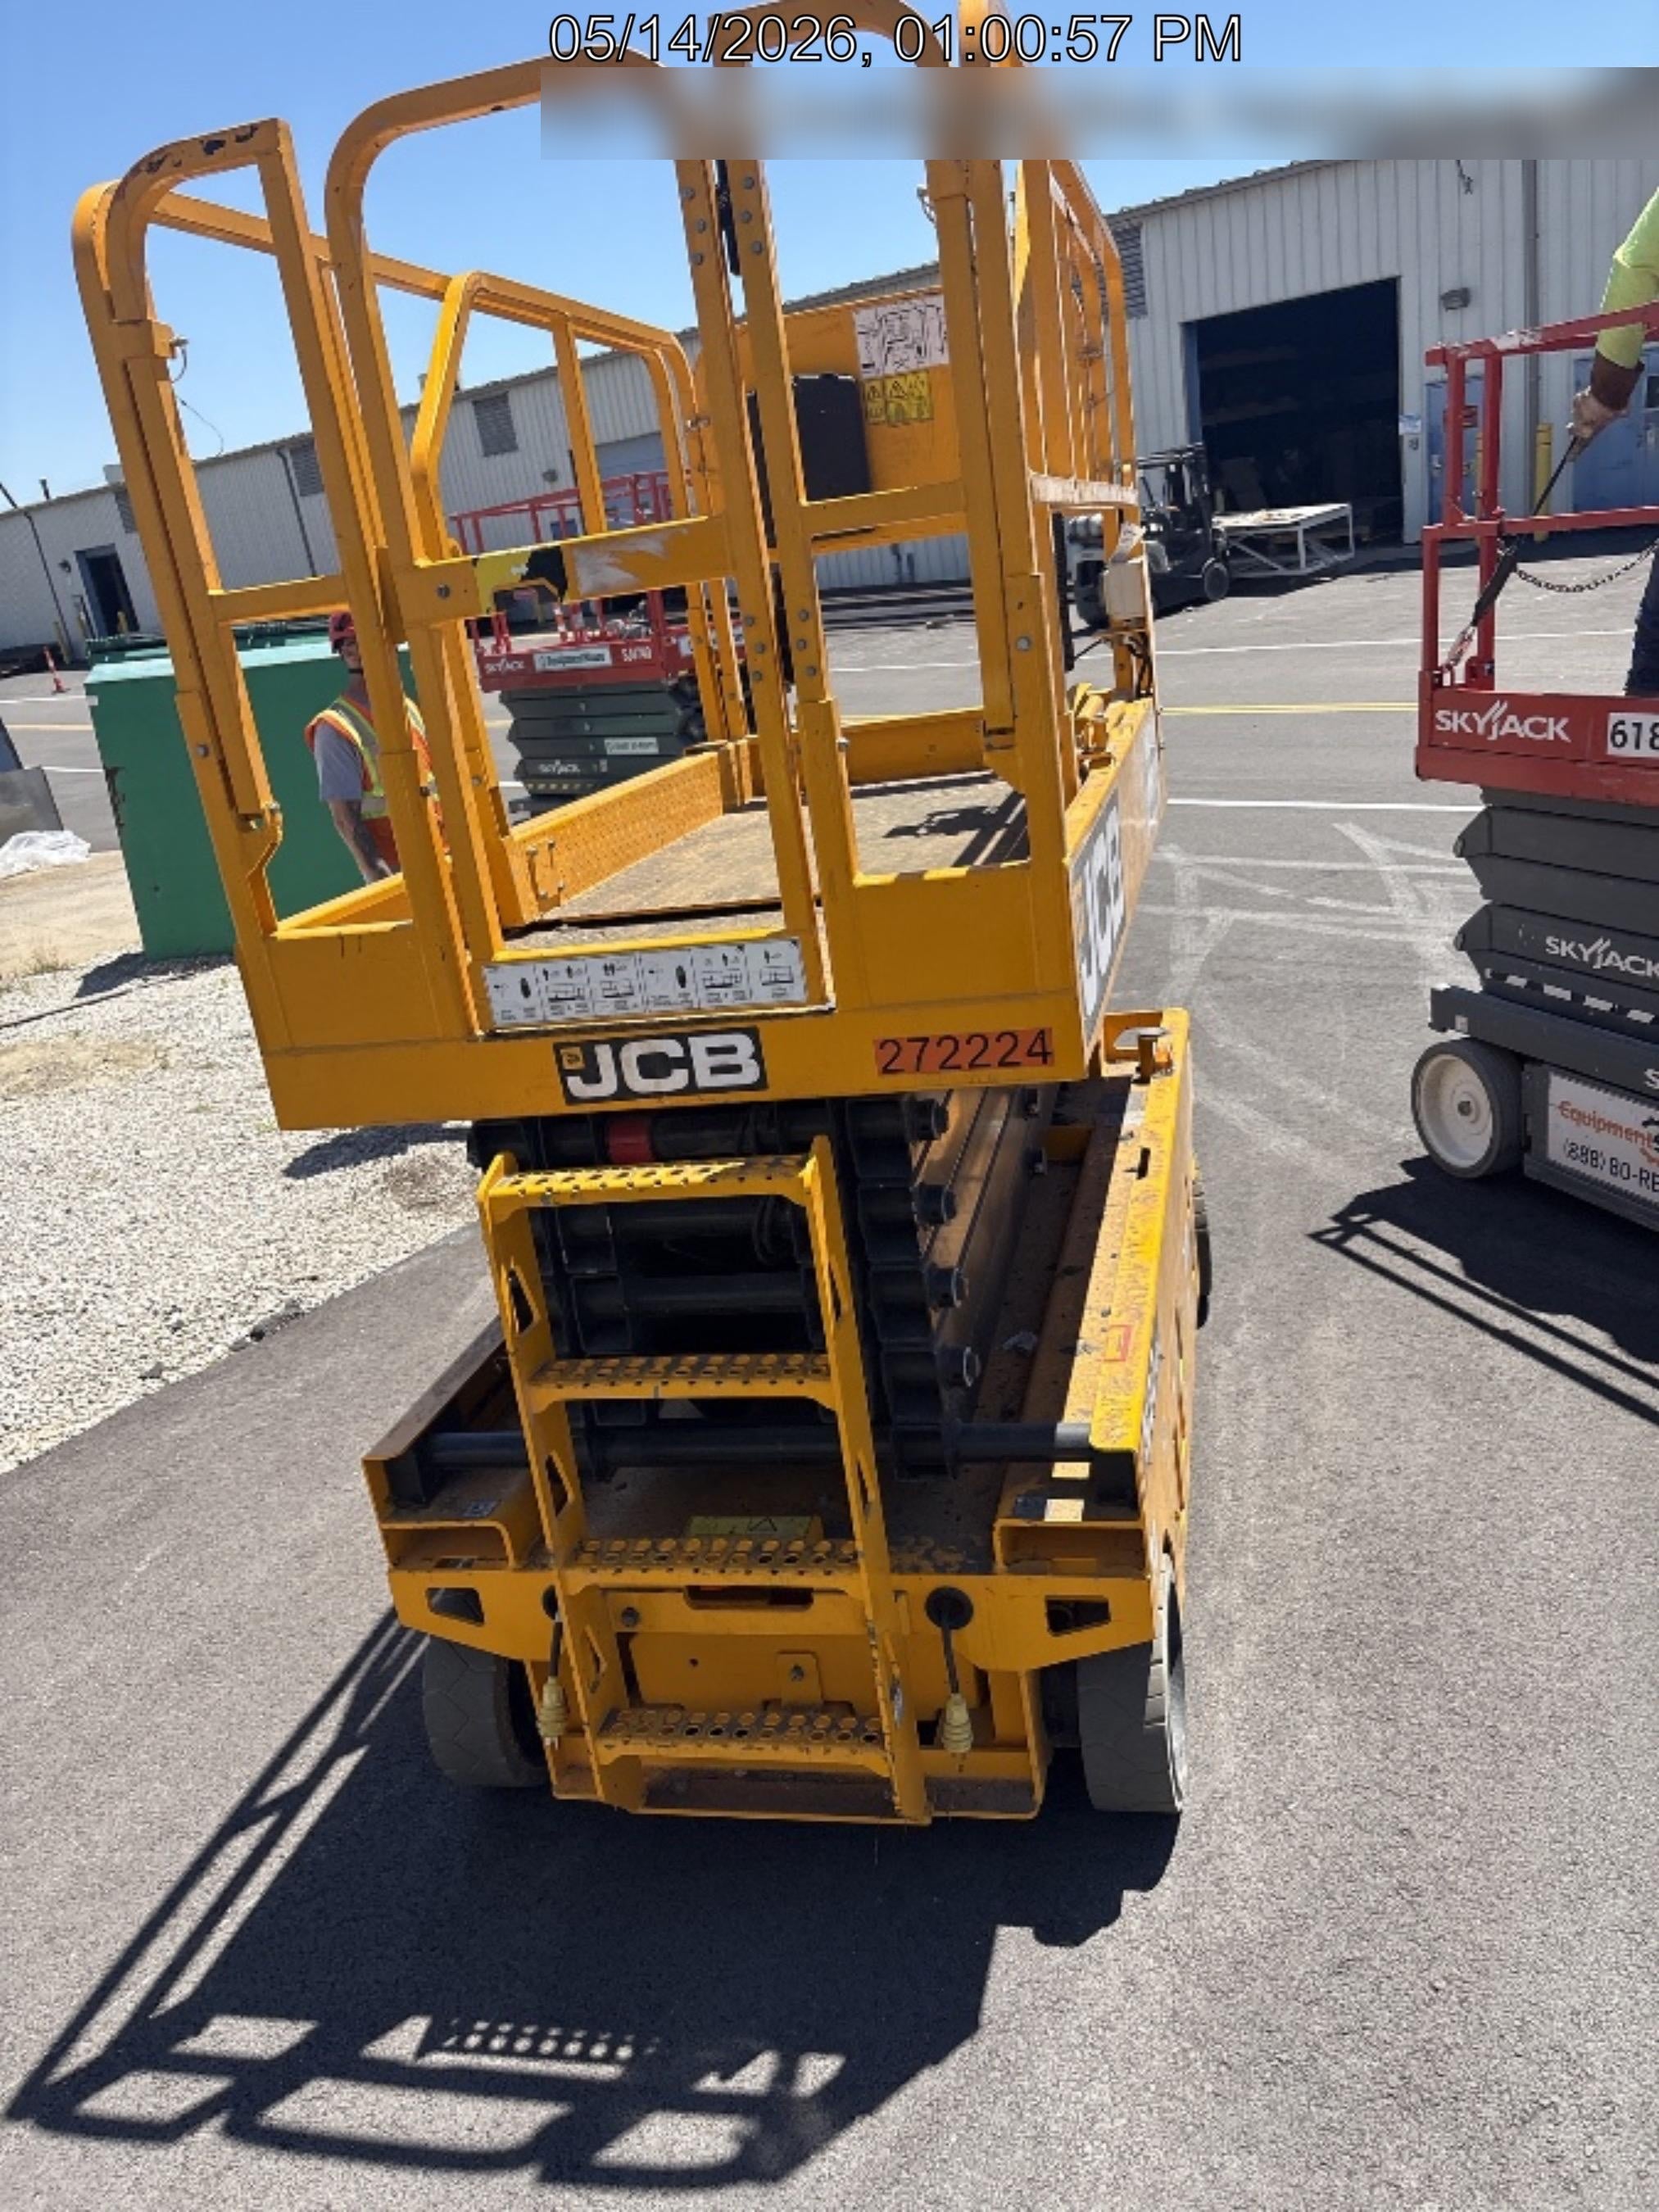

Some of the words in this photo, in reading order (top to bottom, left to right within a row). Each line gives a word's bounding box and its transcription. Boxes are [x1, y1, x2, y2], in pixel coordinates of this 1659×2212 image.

[1435, 700, 1571, 742] SKYJACK
[567, 1034, 760, 1099] JCB
[879, 1029, 1052, 1074] 272224
